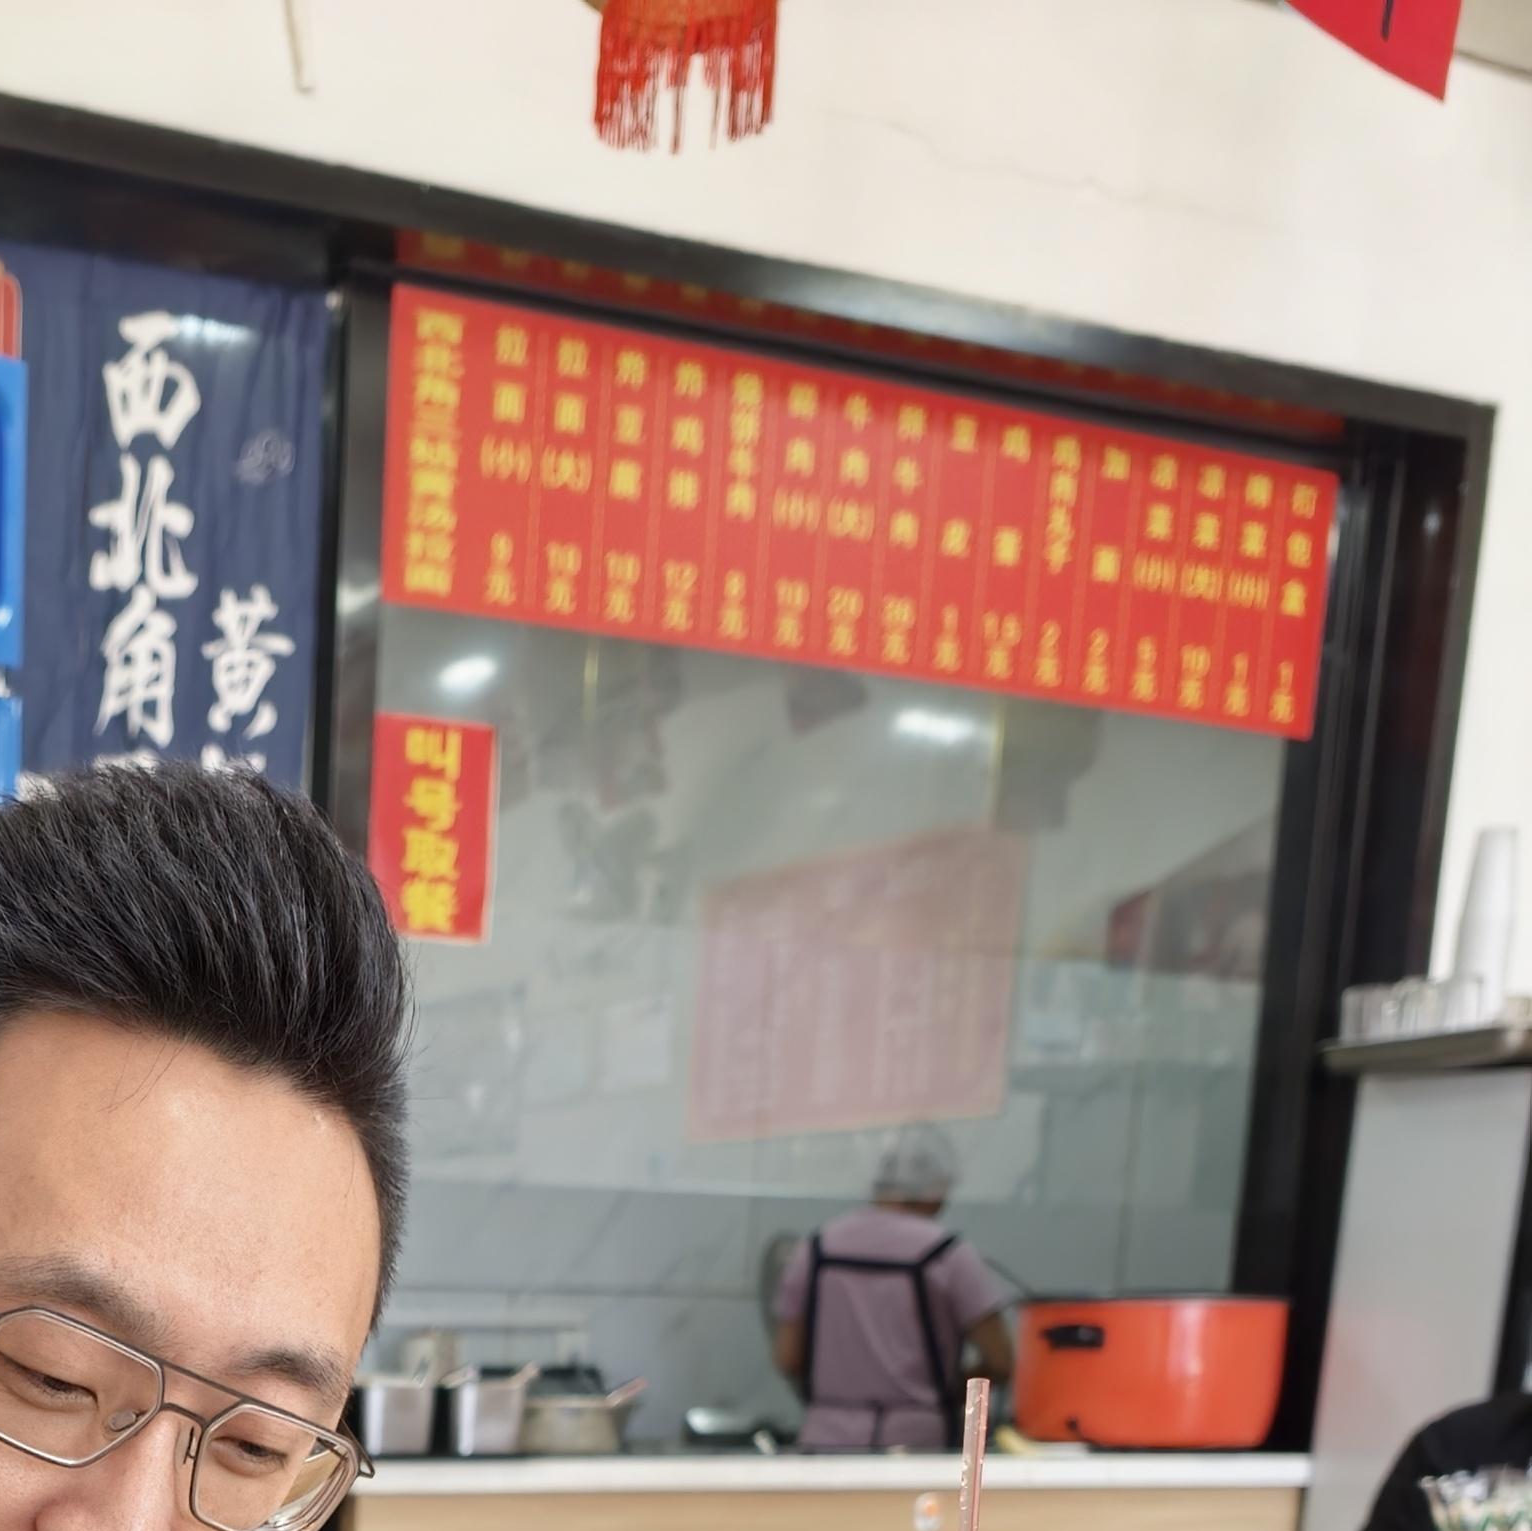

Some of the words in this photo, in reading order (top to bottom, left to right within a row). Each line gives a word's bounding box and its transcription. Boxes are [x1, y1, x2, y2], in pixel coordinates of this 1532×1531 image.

[90, 310, 202, 775] 西北角
[402, 729, 463, 932] 叫号取餐
